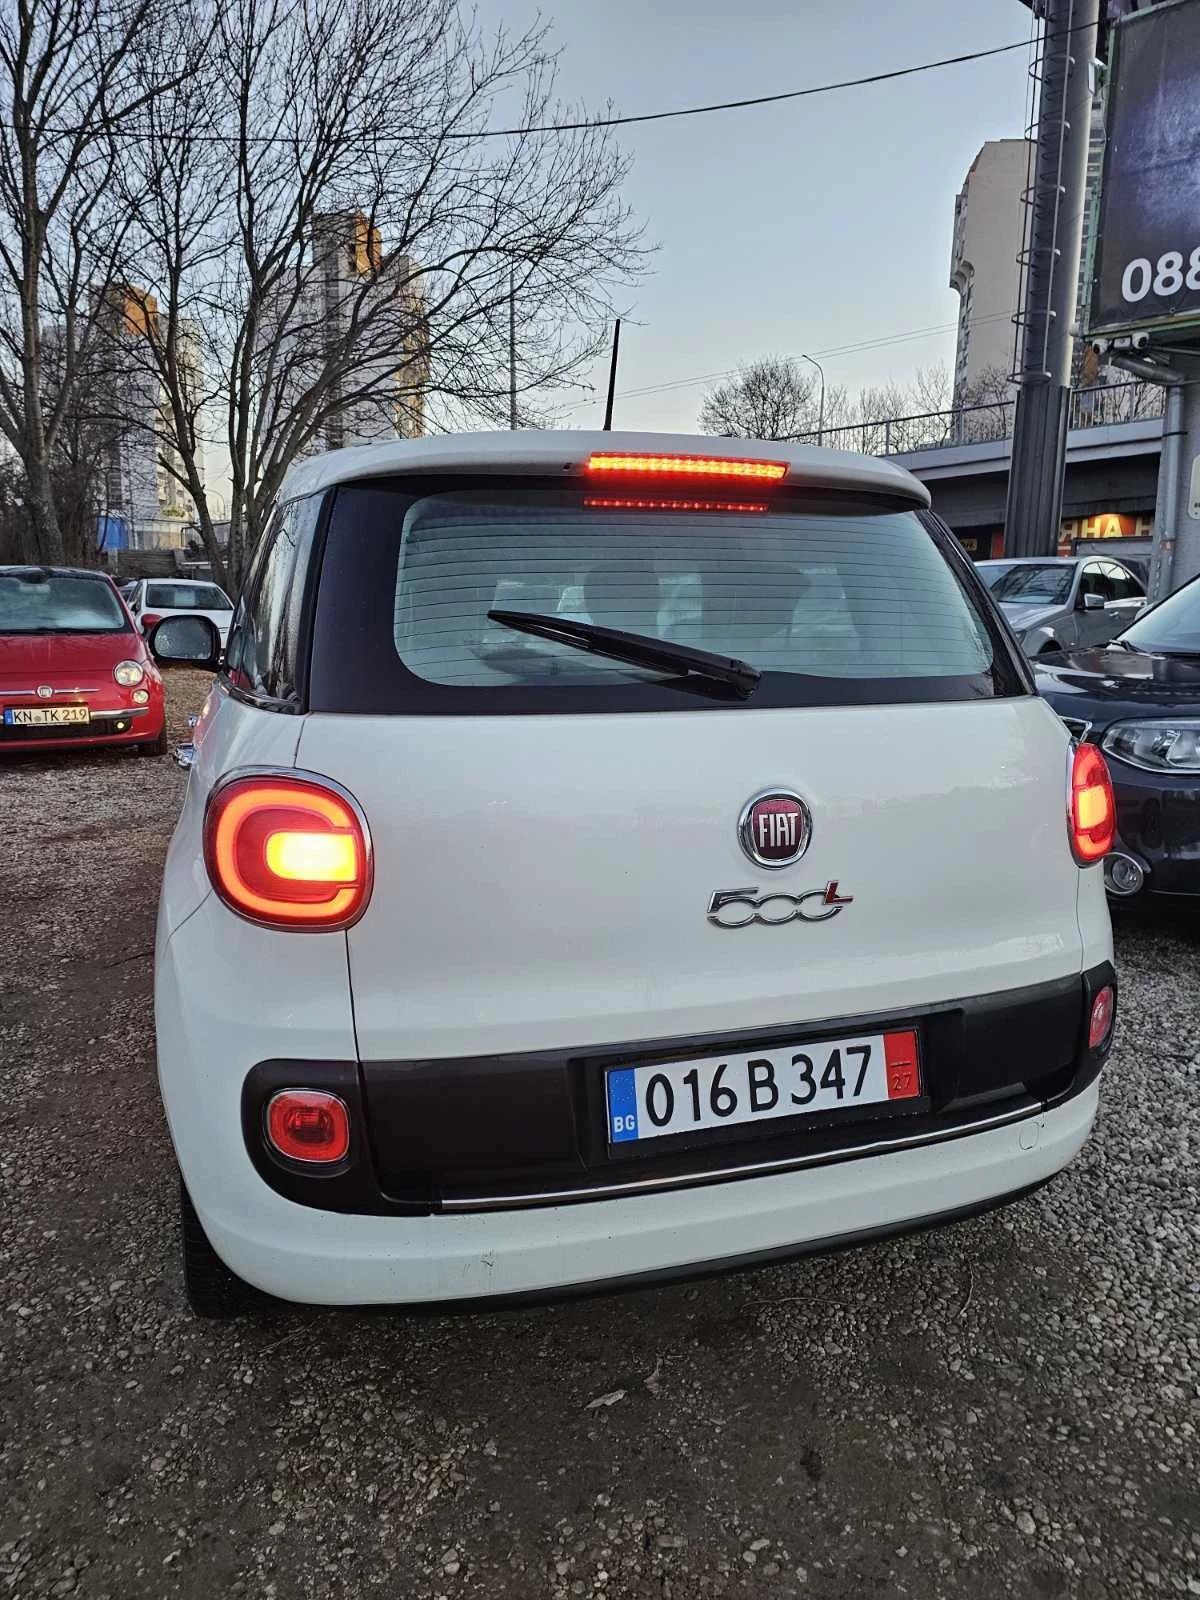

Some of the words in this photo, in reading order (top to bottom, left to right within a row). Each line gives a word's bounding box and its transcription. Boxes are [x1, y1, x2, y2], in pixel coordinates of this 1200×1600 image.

[13, 711, 32, 722] KN
[41, 709, 60, 722] TK
[62, 708, 87, 721] 219
[758, 812, 799, 848] FIAT
[613, 1114, 636, 1133] BG
[892, 1071, 912, 1091] 27
